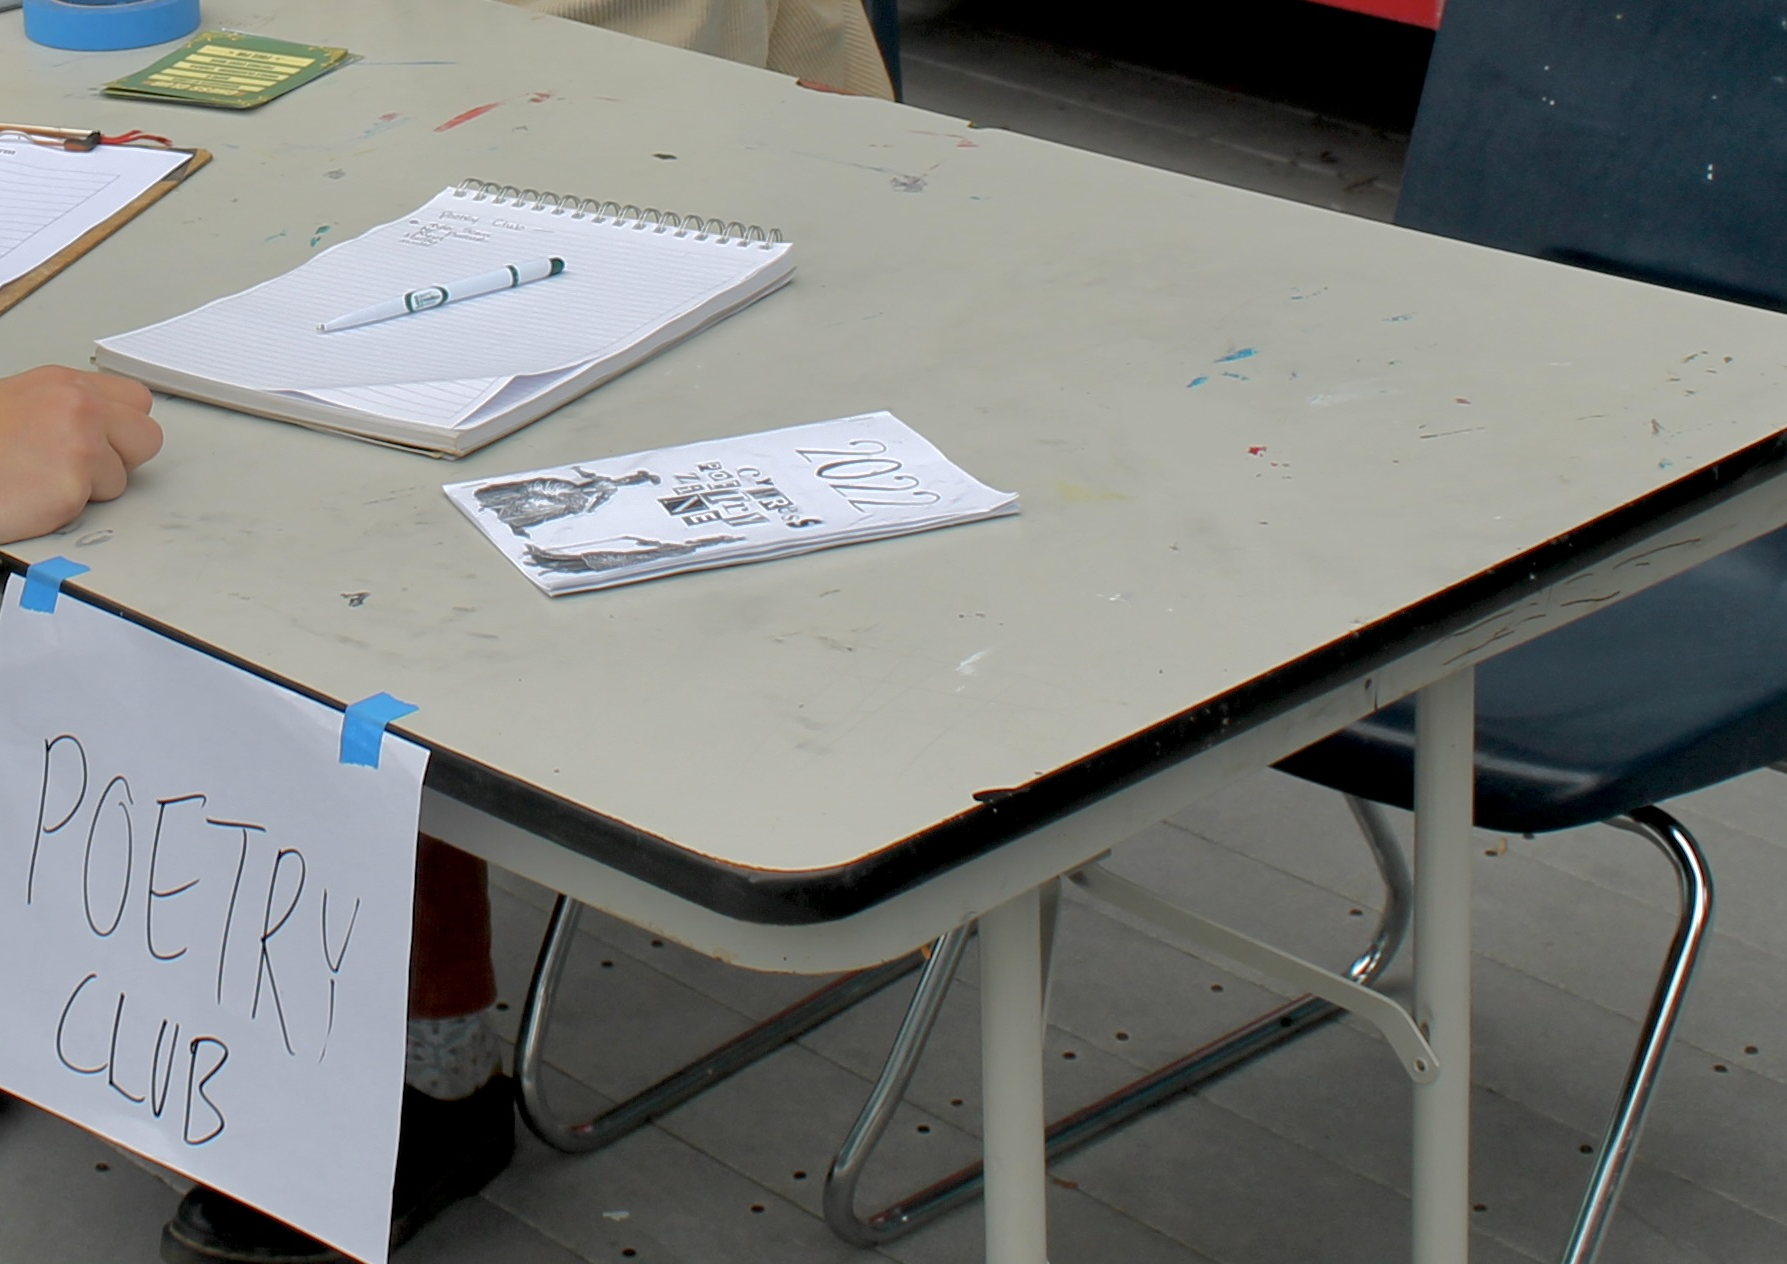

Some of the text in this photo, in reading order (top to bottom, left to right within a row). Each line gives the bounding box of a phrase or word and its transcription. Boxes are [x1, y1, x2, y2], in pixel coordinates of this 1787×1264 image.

[795, 439, 941, 513] 2022
[27, 733, 360, 1064] POETRY
[56, 972, 229, 1146] CLUB
